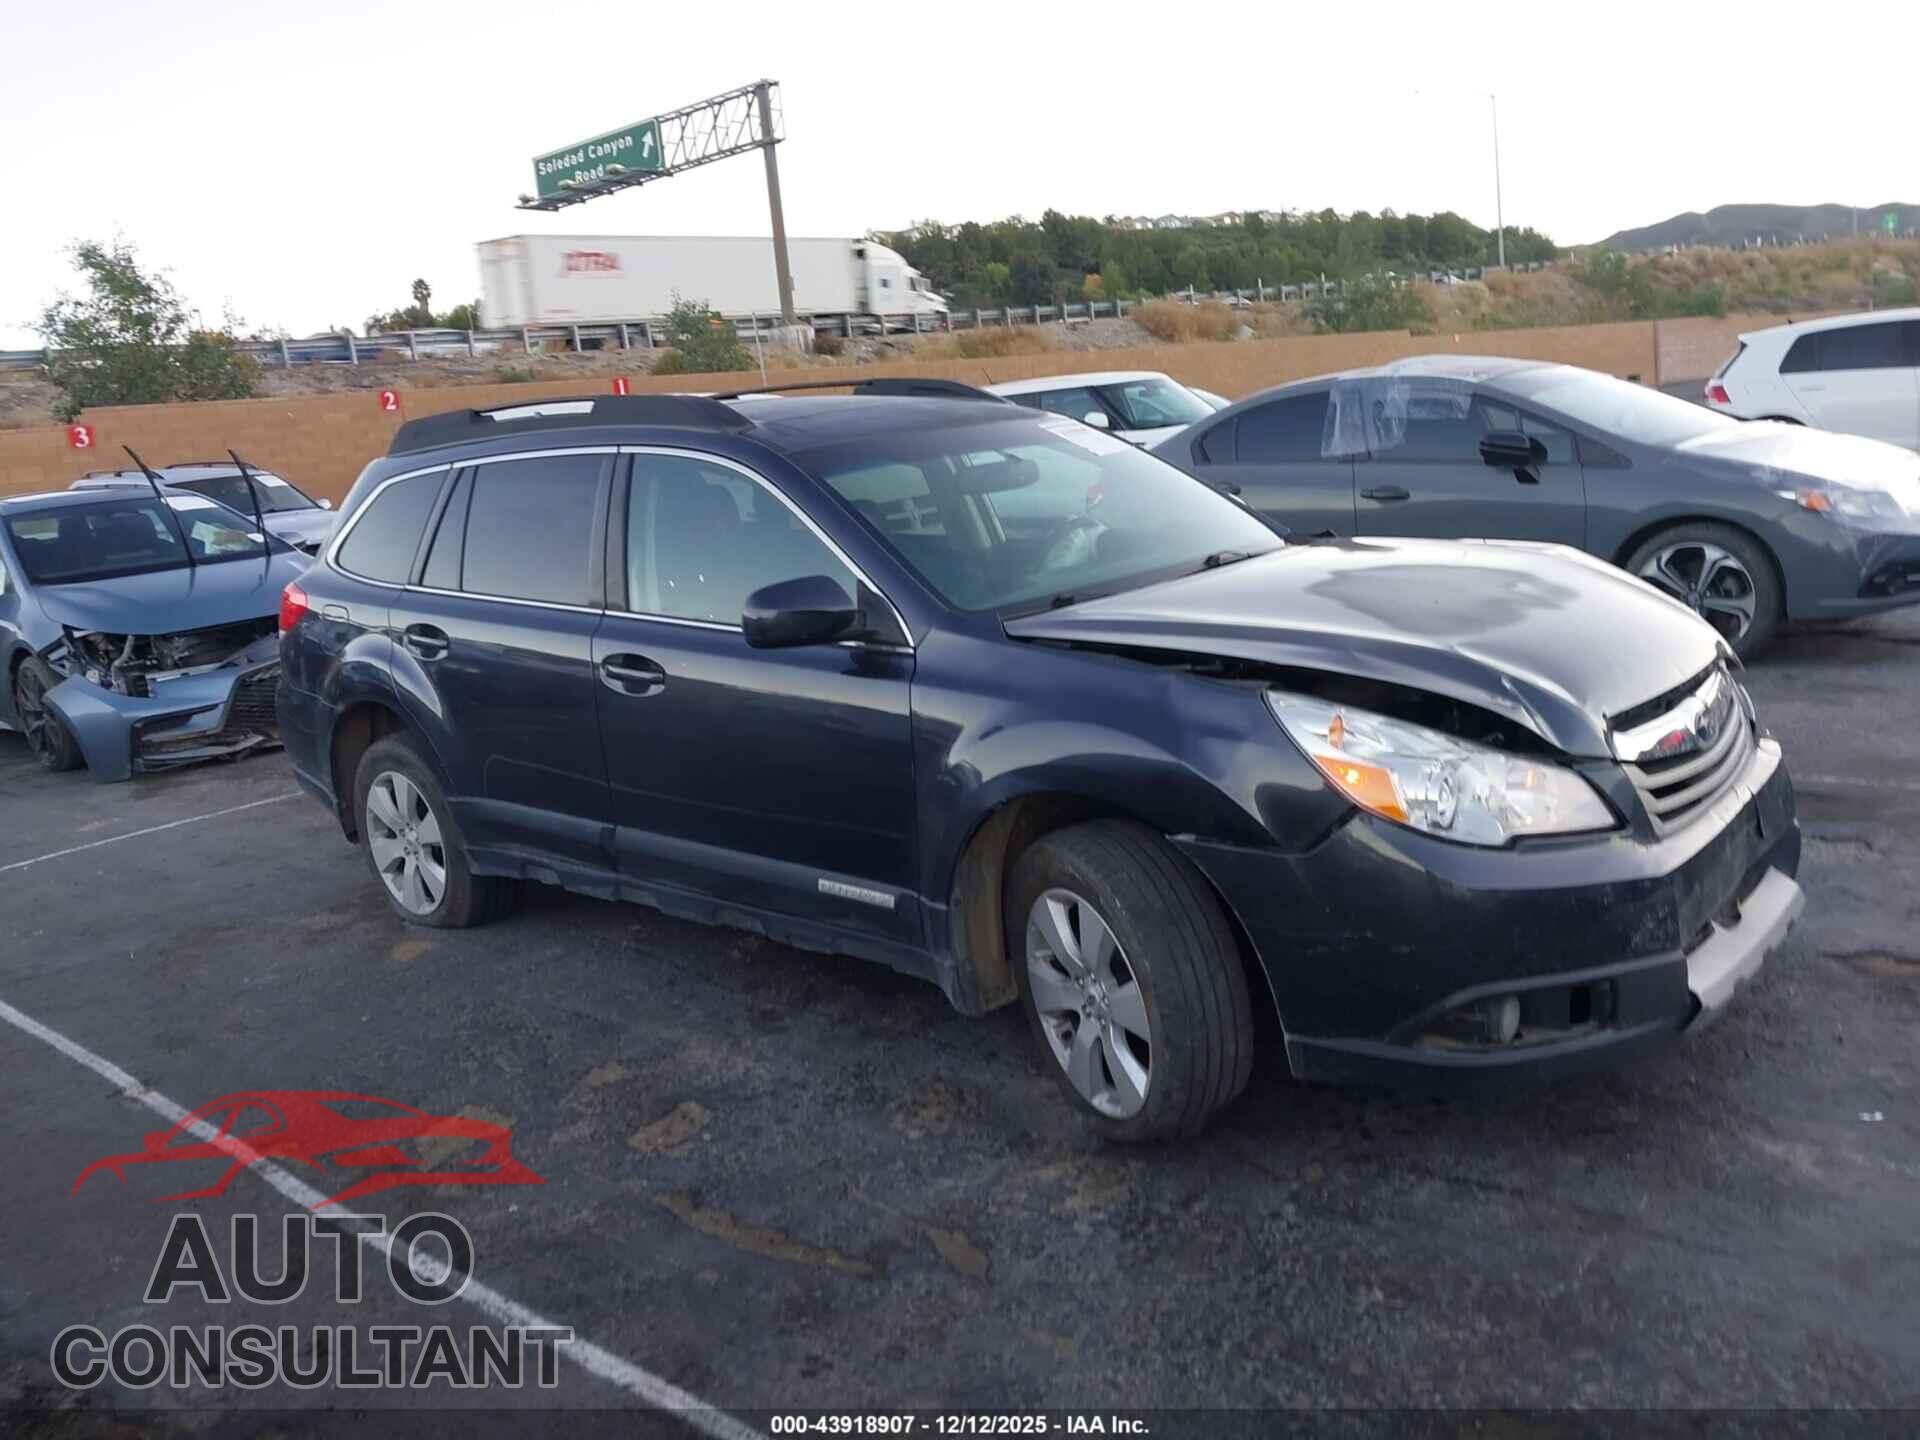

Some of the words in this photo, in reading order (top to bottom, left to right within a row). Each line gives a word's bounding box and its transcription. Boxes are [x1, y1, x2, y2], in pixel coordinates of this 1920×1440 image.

[538, 150, 585, 175] Soledad
[588, 135, 633, 158] Canyon
[575, 164, 605, 184] Road
[383, 391, 397, 410] 2
[73, 426, 89, 448] 3
